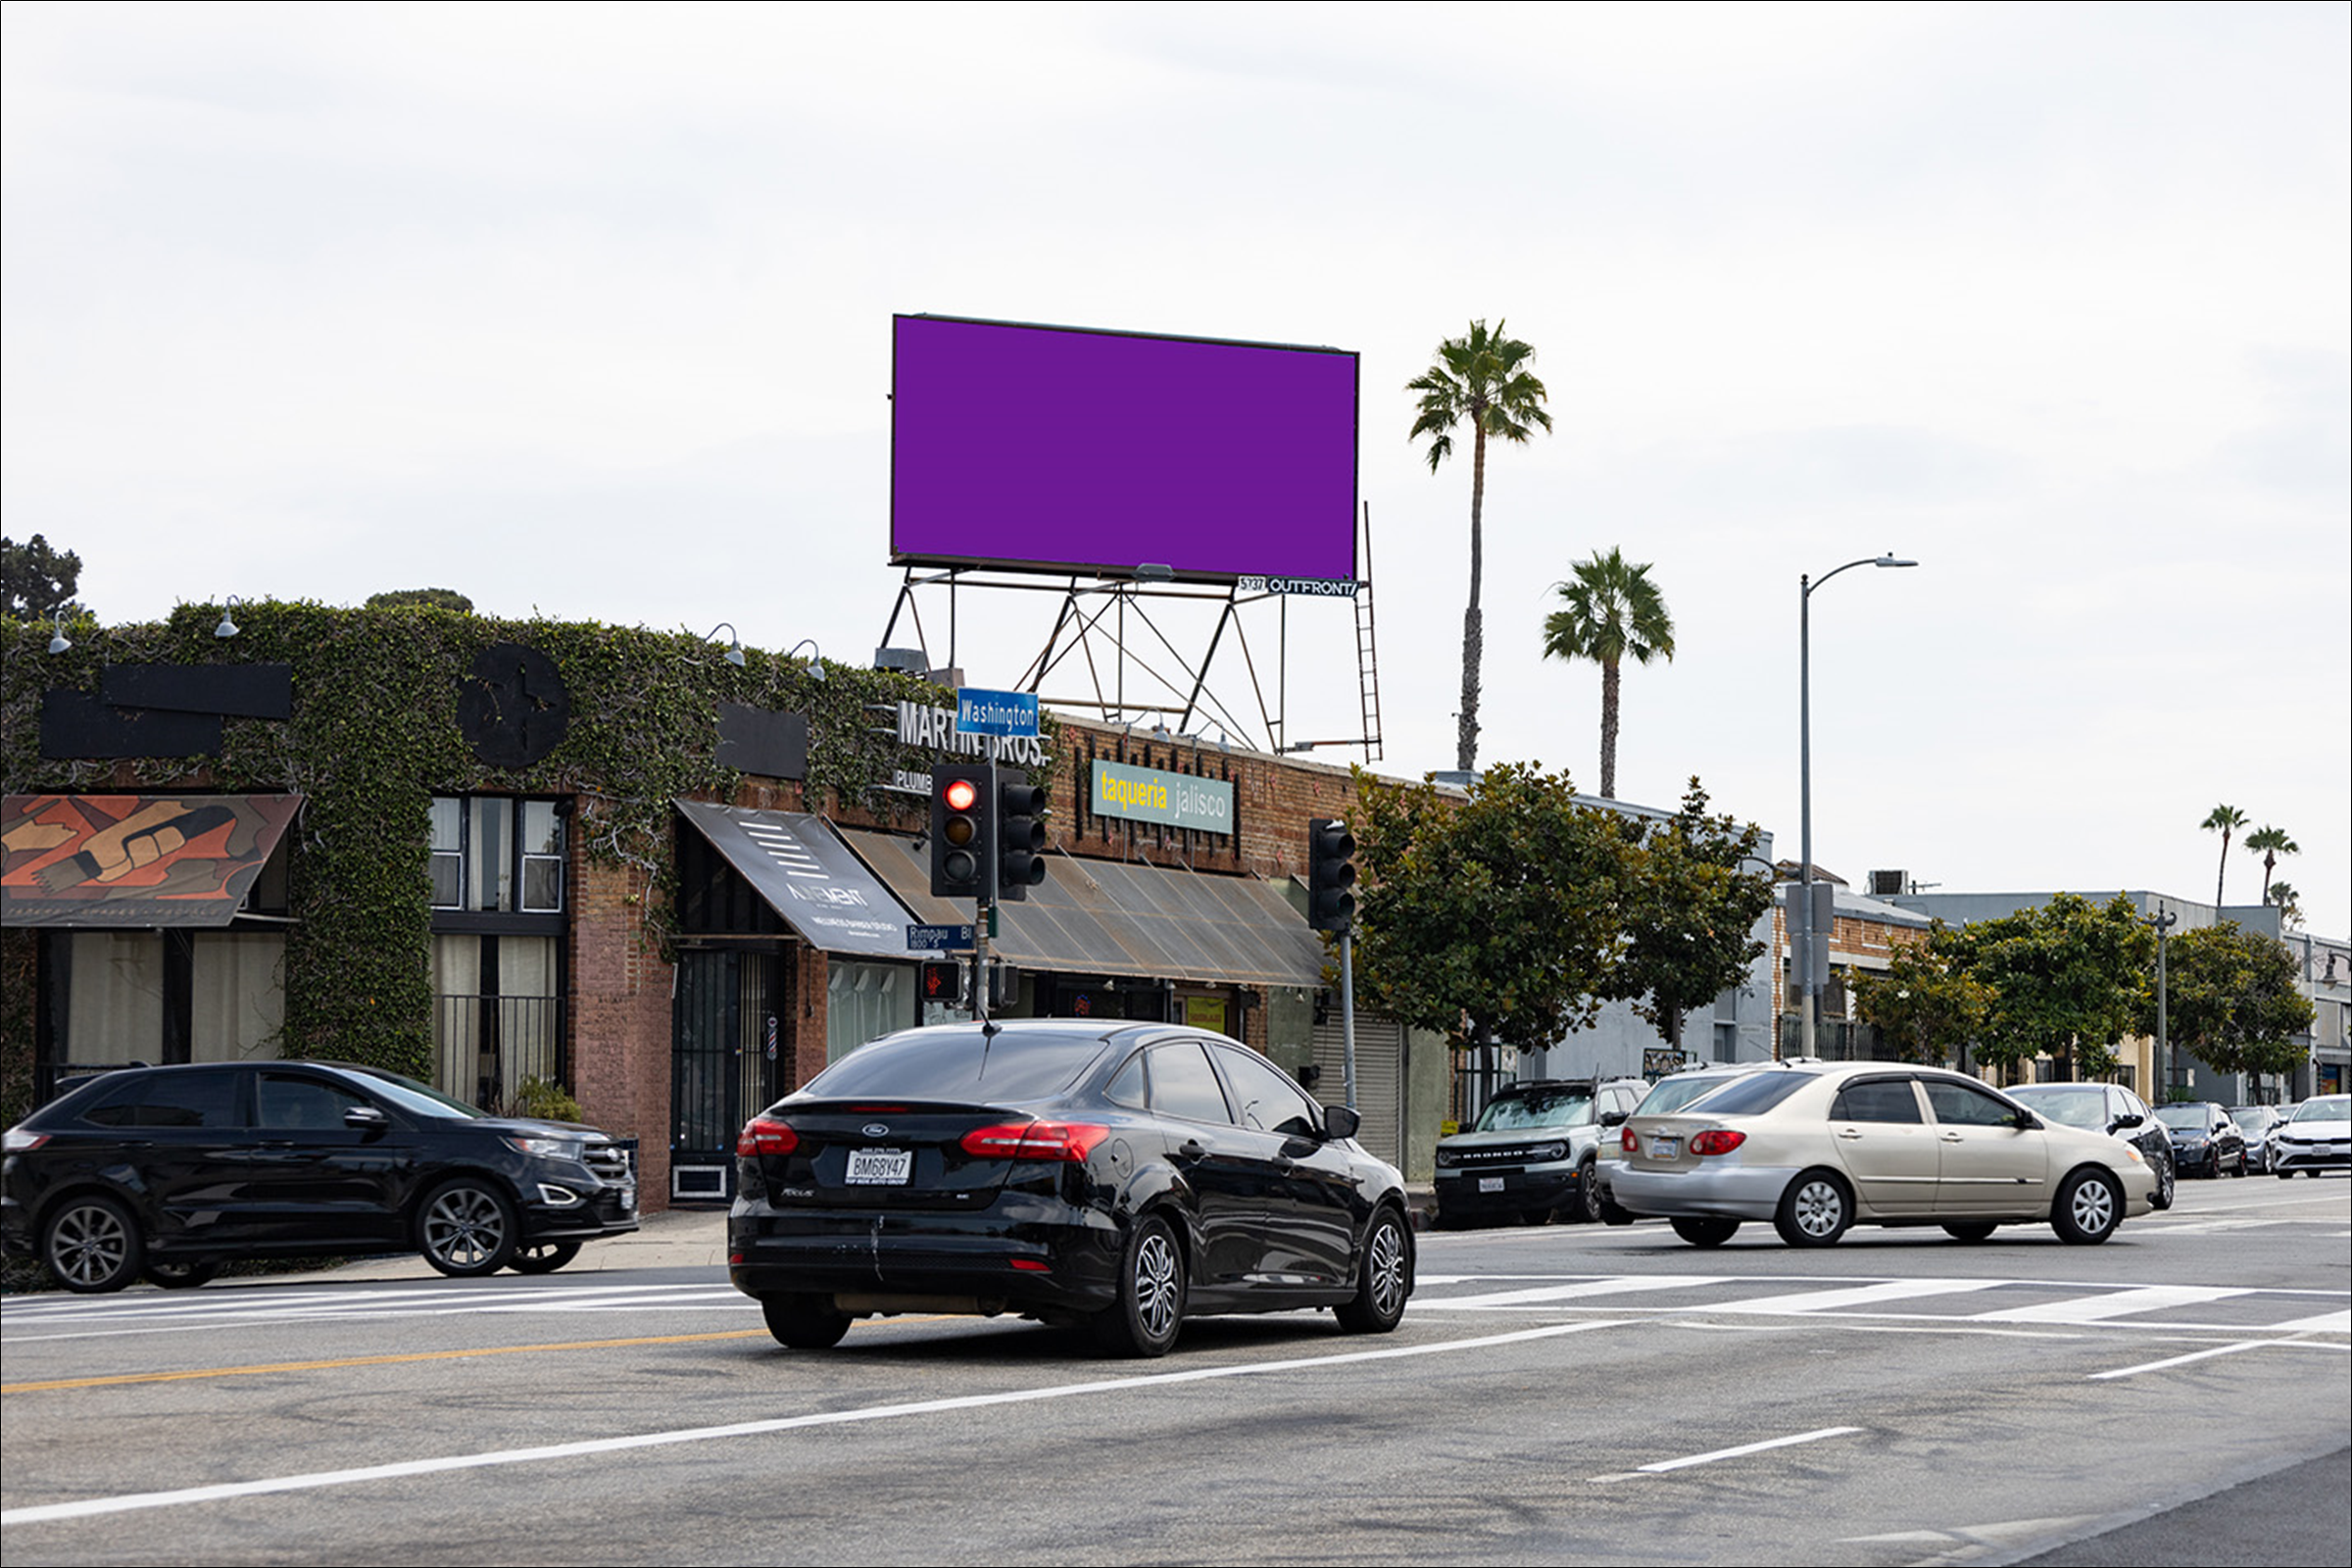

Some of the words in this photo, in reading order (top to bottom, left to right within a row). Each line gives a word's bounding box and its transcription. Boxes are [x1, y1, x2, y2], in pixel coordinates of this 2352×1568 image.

[961, 699, 1035, 732] Washington
[1101, 770, 1167, 811] taqueria
[1175, 782, 1226, 818] jalisco
[909, 926, 949, 942] Rimpau
